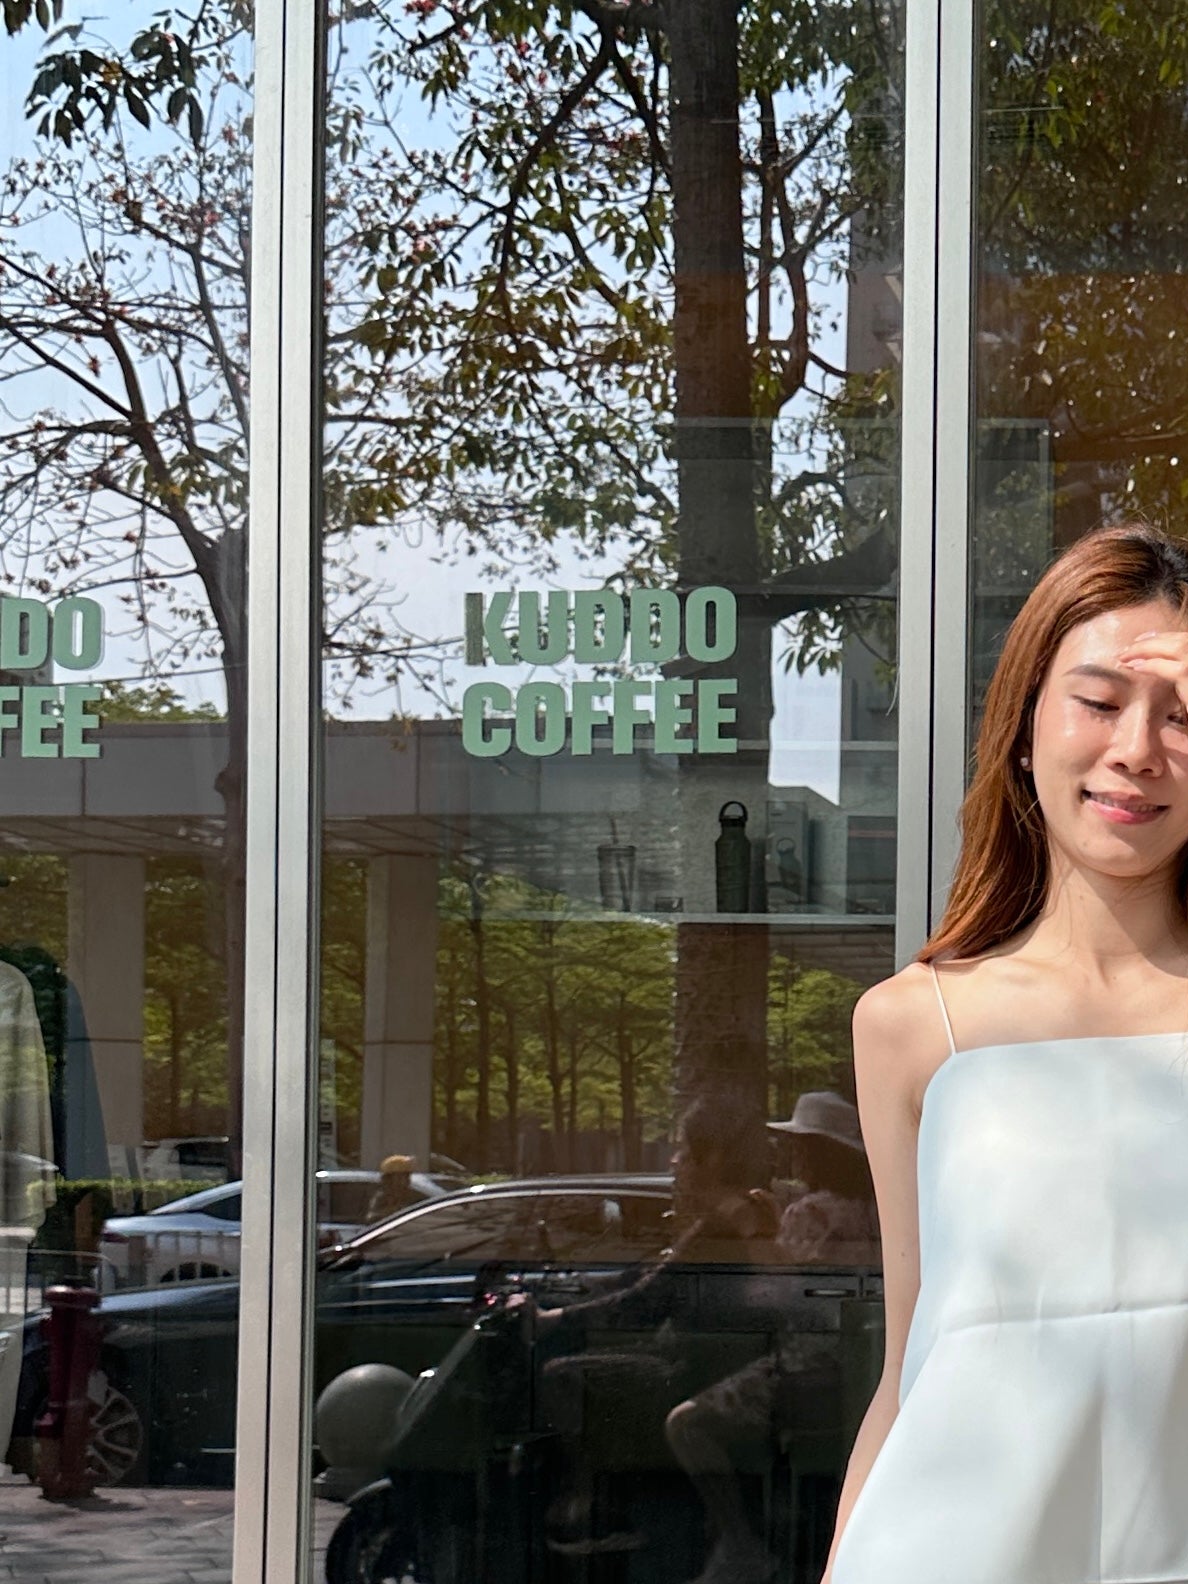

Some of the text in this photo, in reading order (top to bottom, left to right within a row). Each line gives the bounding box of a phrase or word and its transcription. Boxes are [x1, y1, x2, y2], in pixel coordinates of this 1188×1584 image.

[0, 597, 103, 670] DO
[465, 586, 737, 666] KUDDO
[462, 679, 737, 757] COFFEE
